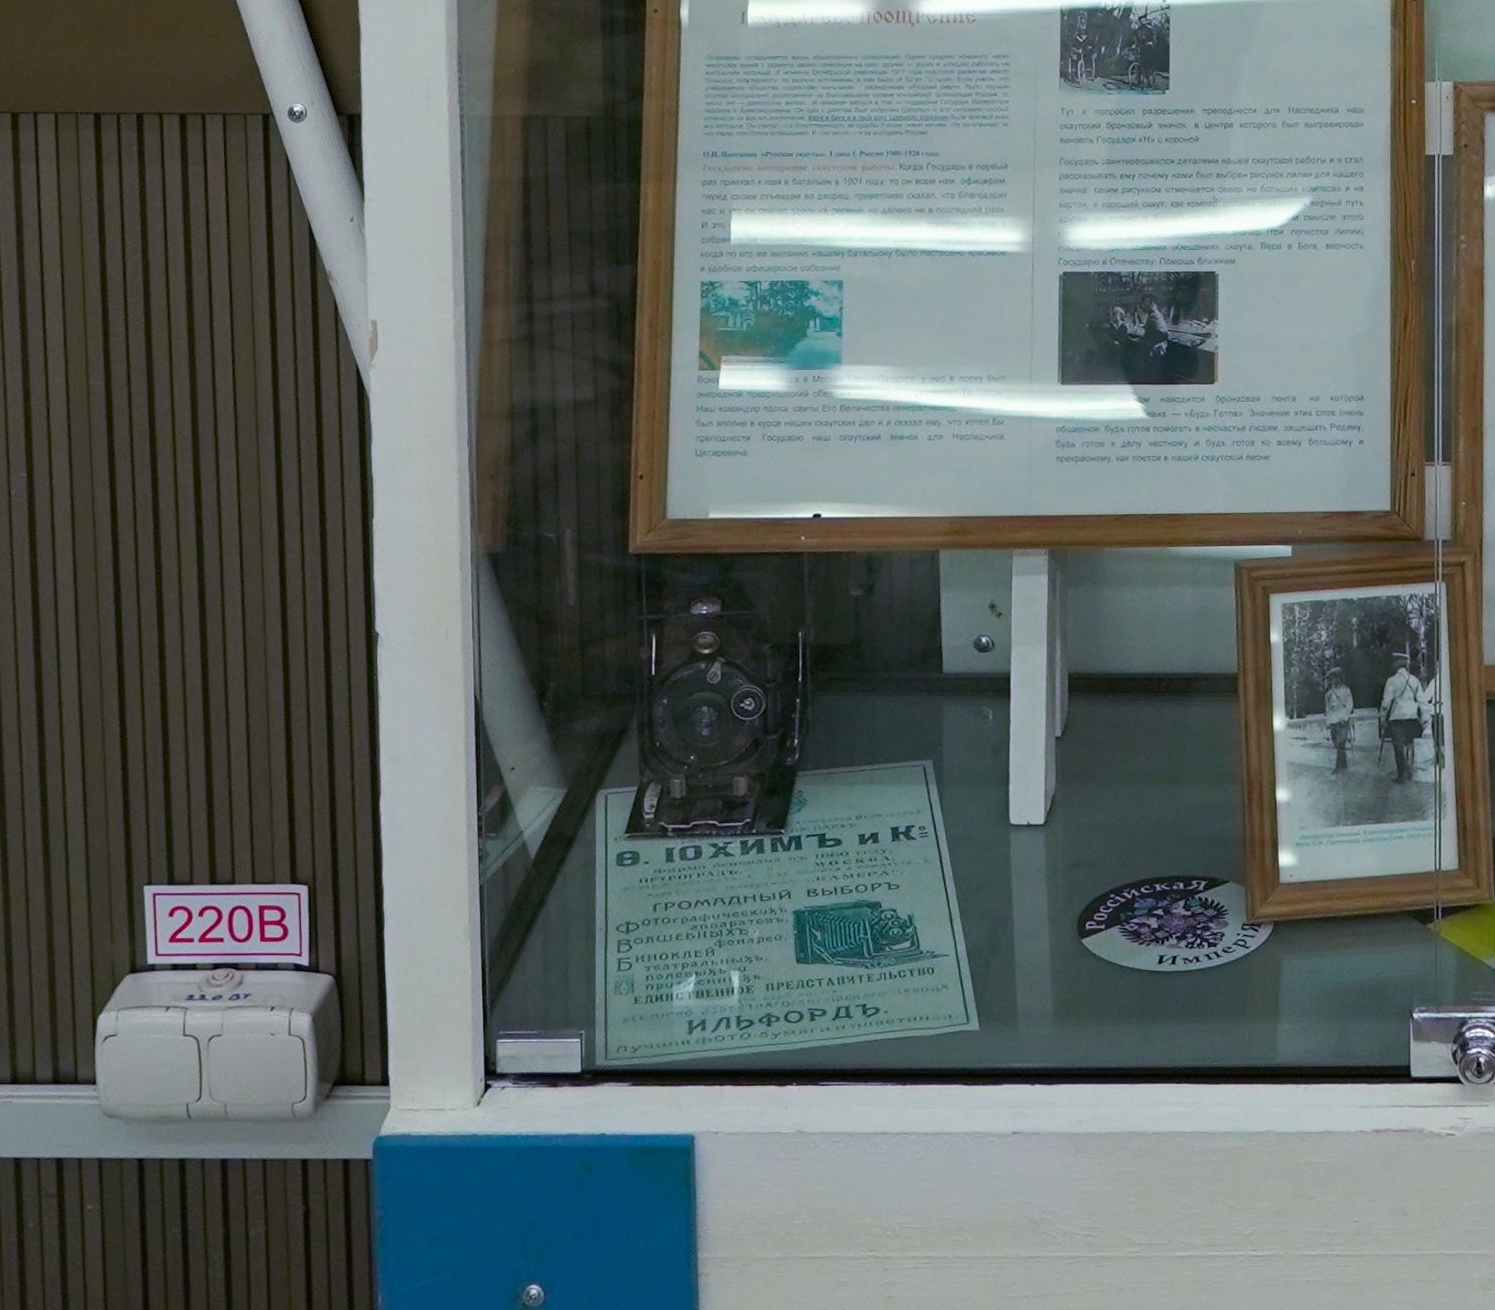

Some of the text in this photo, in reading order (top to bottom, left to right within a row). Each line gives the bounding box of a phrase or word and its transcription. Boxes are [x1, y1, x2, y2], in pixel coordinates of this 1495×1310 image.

[653, 881, 900, 912] ГРОМАДНЫЙ ВЫБОРЪ
[766, 967, 935, 992] ПРЕДСТАВИТЕЛЬСТВО
